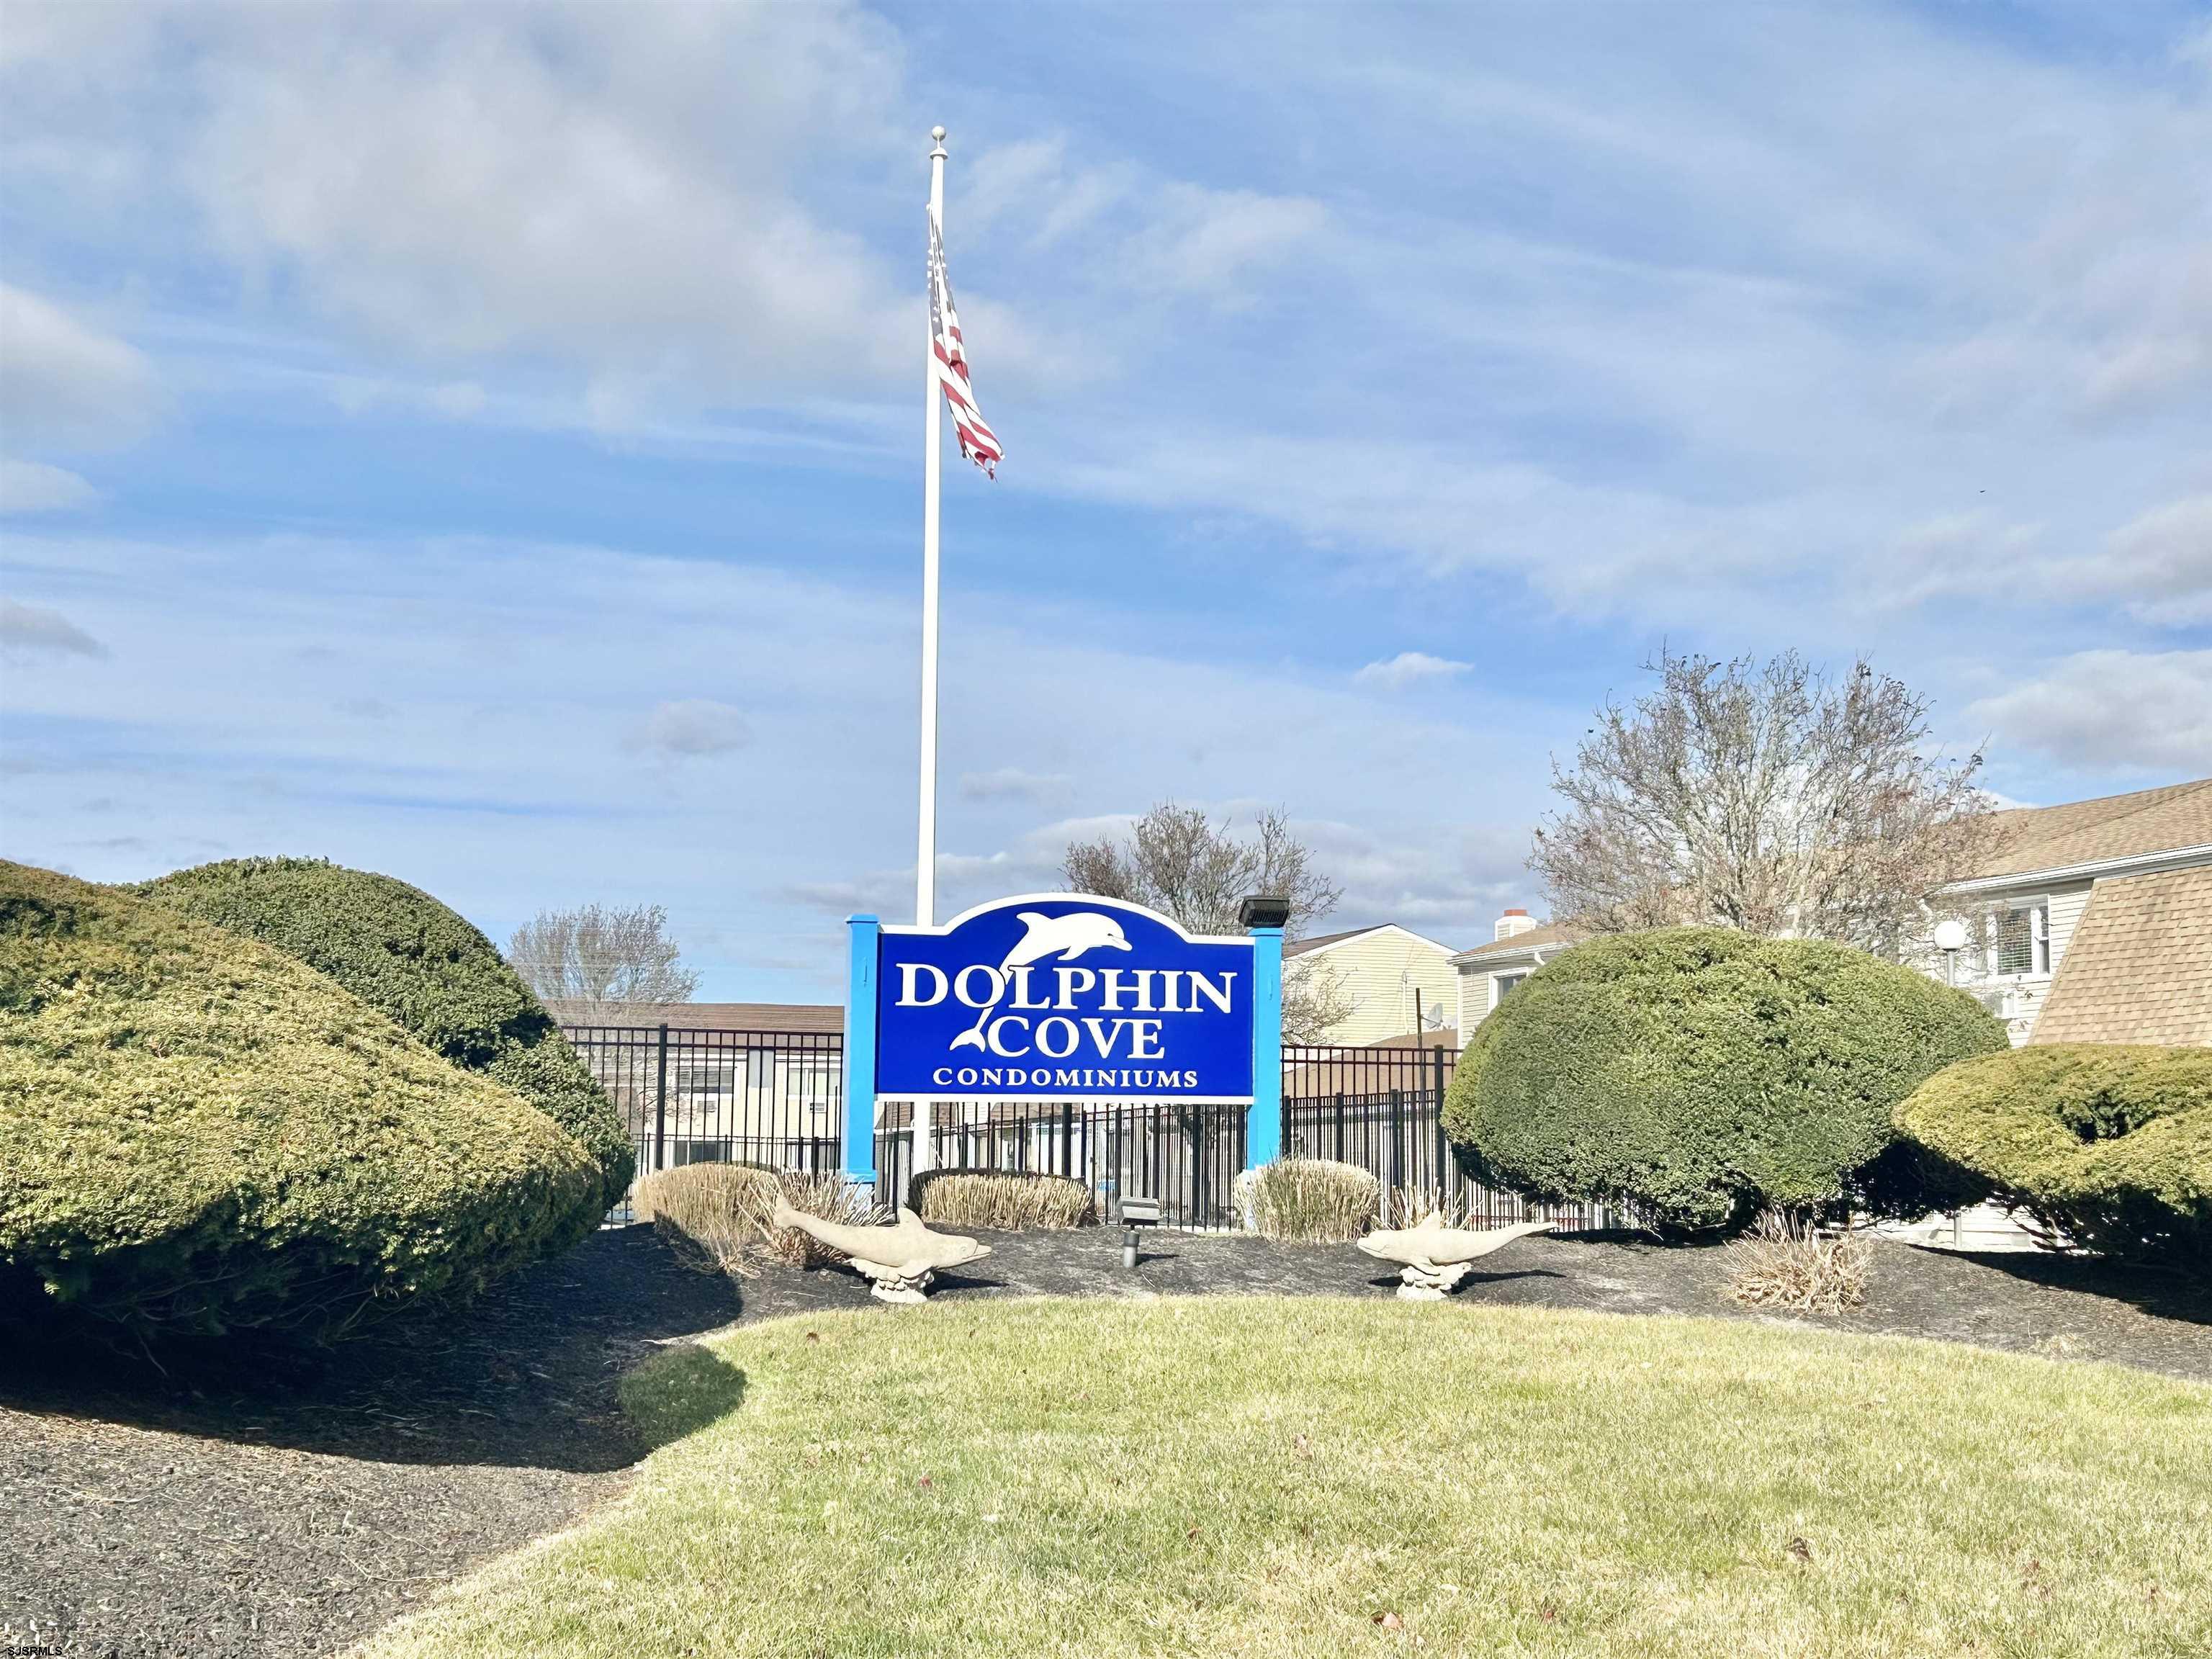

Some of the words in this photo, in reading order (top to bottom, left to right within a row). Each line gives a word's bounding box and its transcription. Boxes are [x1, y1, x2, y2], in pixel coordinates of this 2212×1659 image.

[895, 963, 1238, 1014] DOLPHIN
[988, 1015, 1165, 1059] COVE
[932, 1067, 1198, 1088] CONDOMINIUMS
